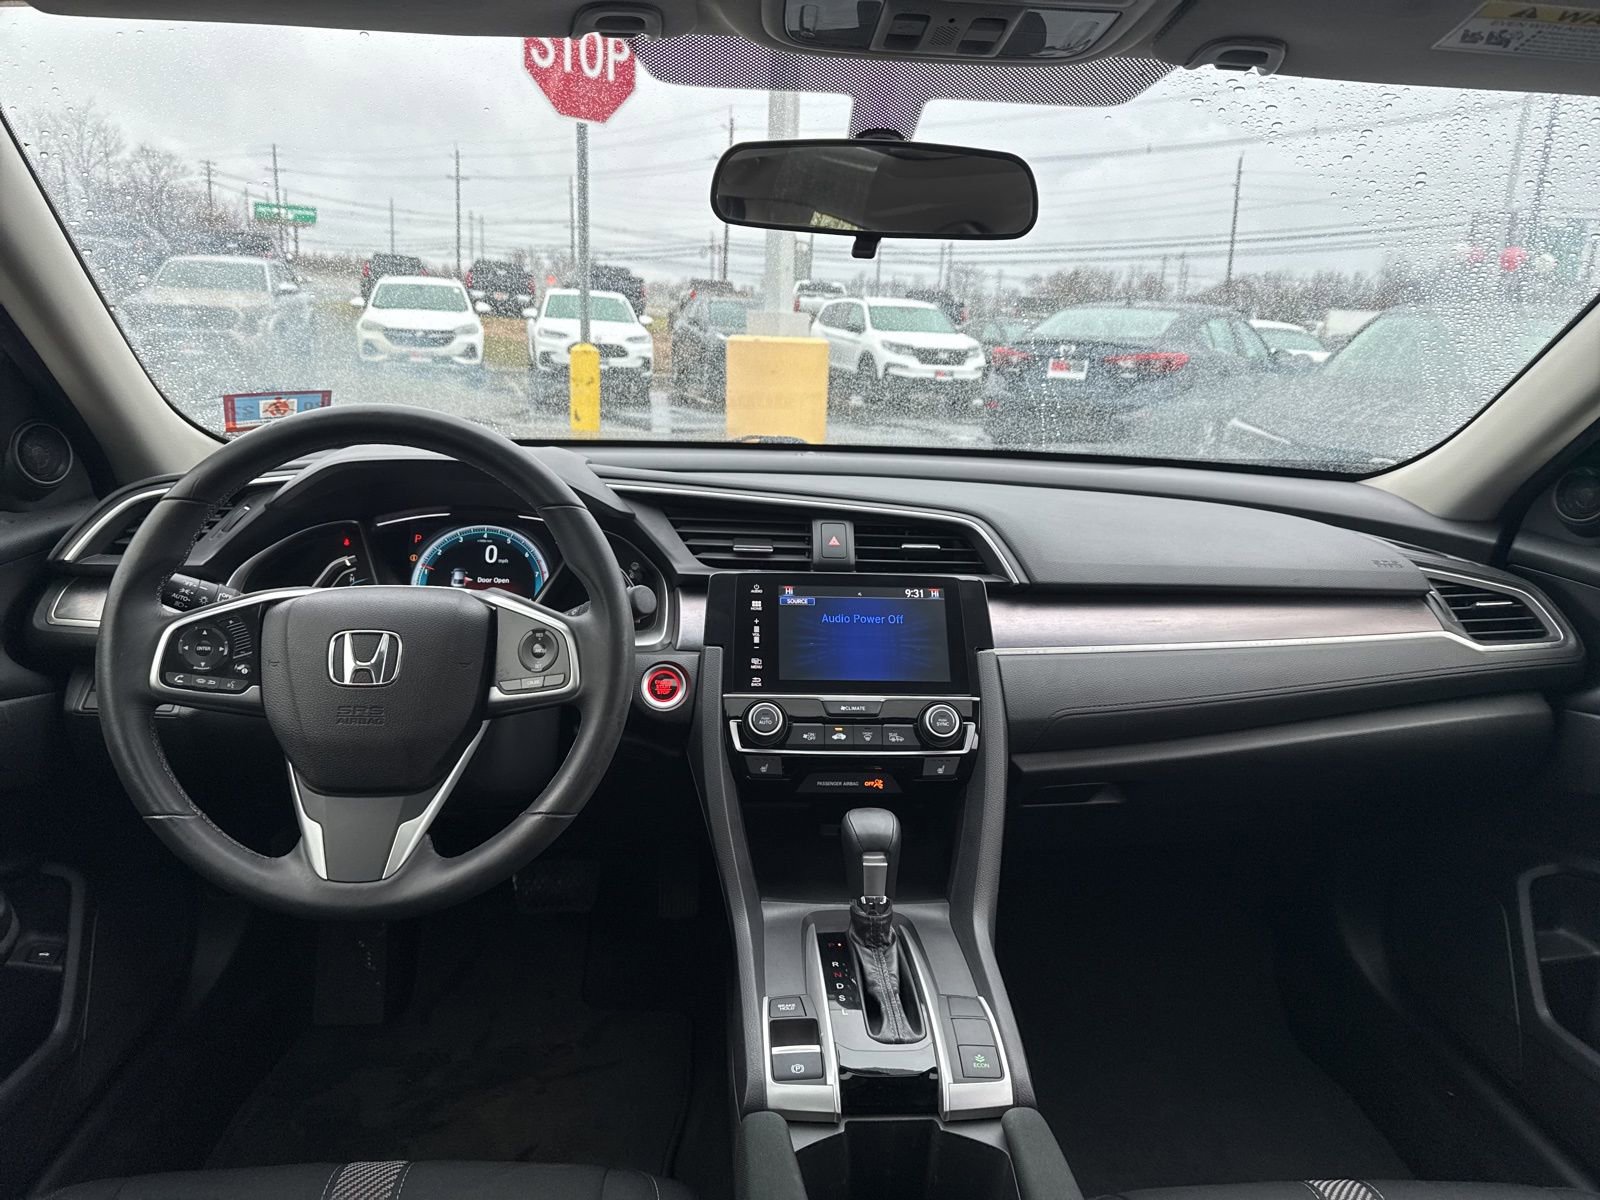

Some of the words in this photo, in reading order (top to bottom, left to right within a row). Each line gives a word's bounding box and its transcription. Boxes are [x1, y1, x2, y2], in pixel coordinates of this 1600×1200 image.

[530, 32, 631, 82] STOP
[415, 534, 422, 543] P
[485, 544, 498, 564] 0
[493, 577, 510, 585] Open
[171, 592, 189, 602] AUTO
[905, 589, 924, 598] 9:31
[821, 614, 850, 624] Audio
[853, 614, 885, 624] Power
[888, 614, 904, 624] Off
